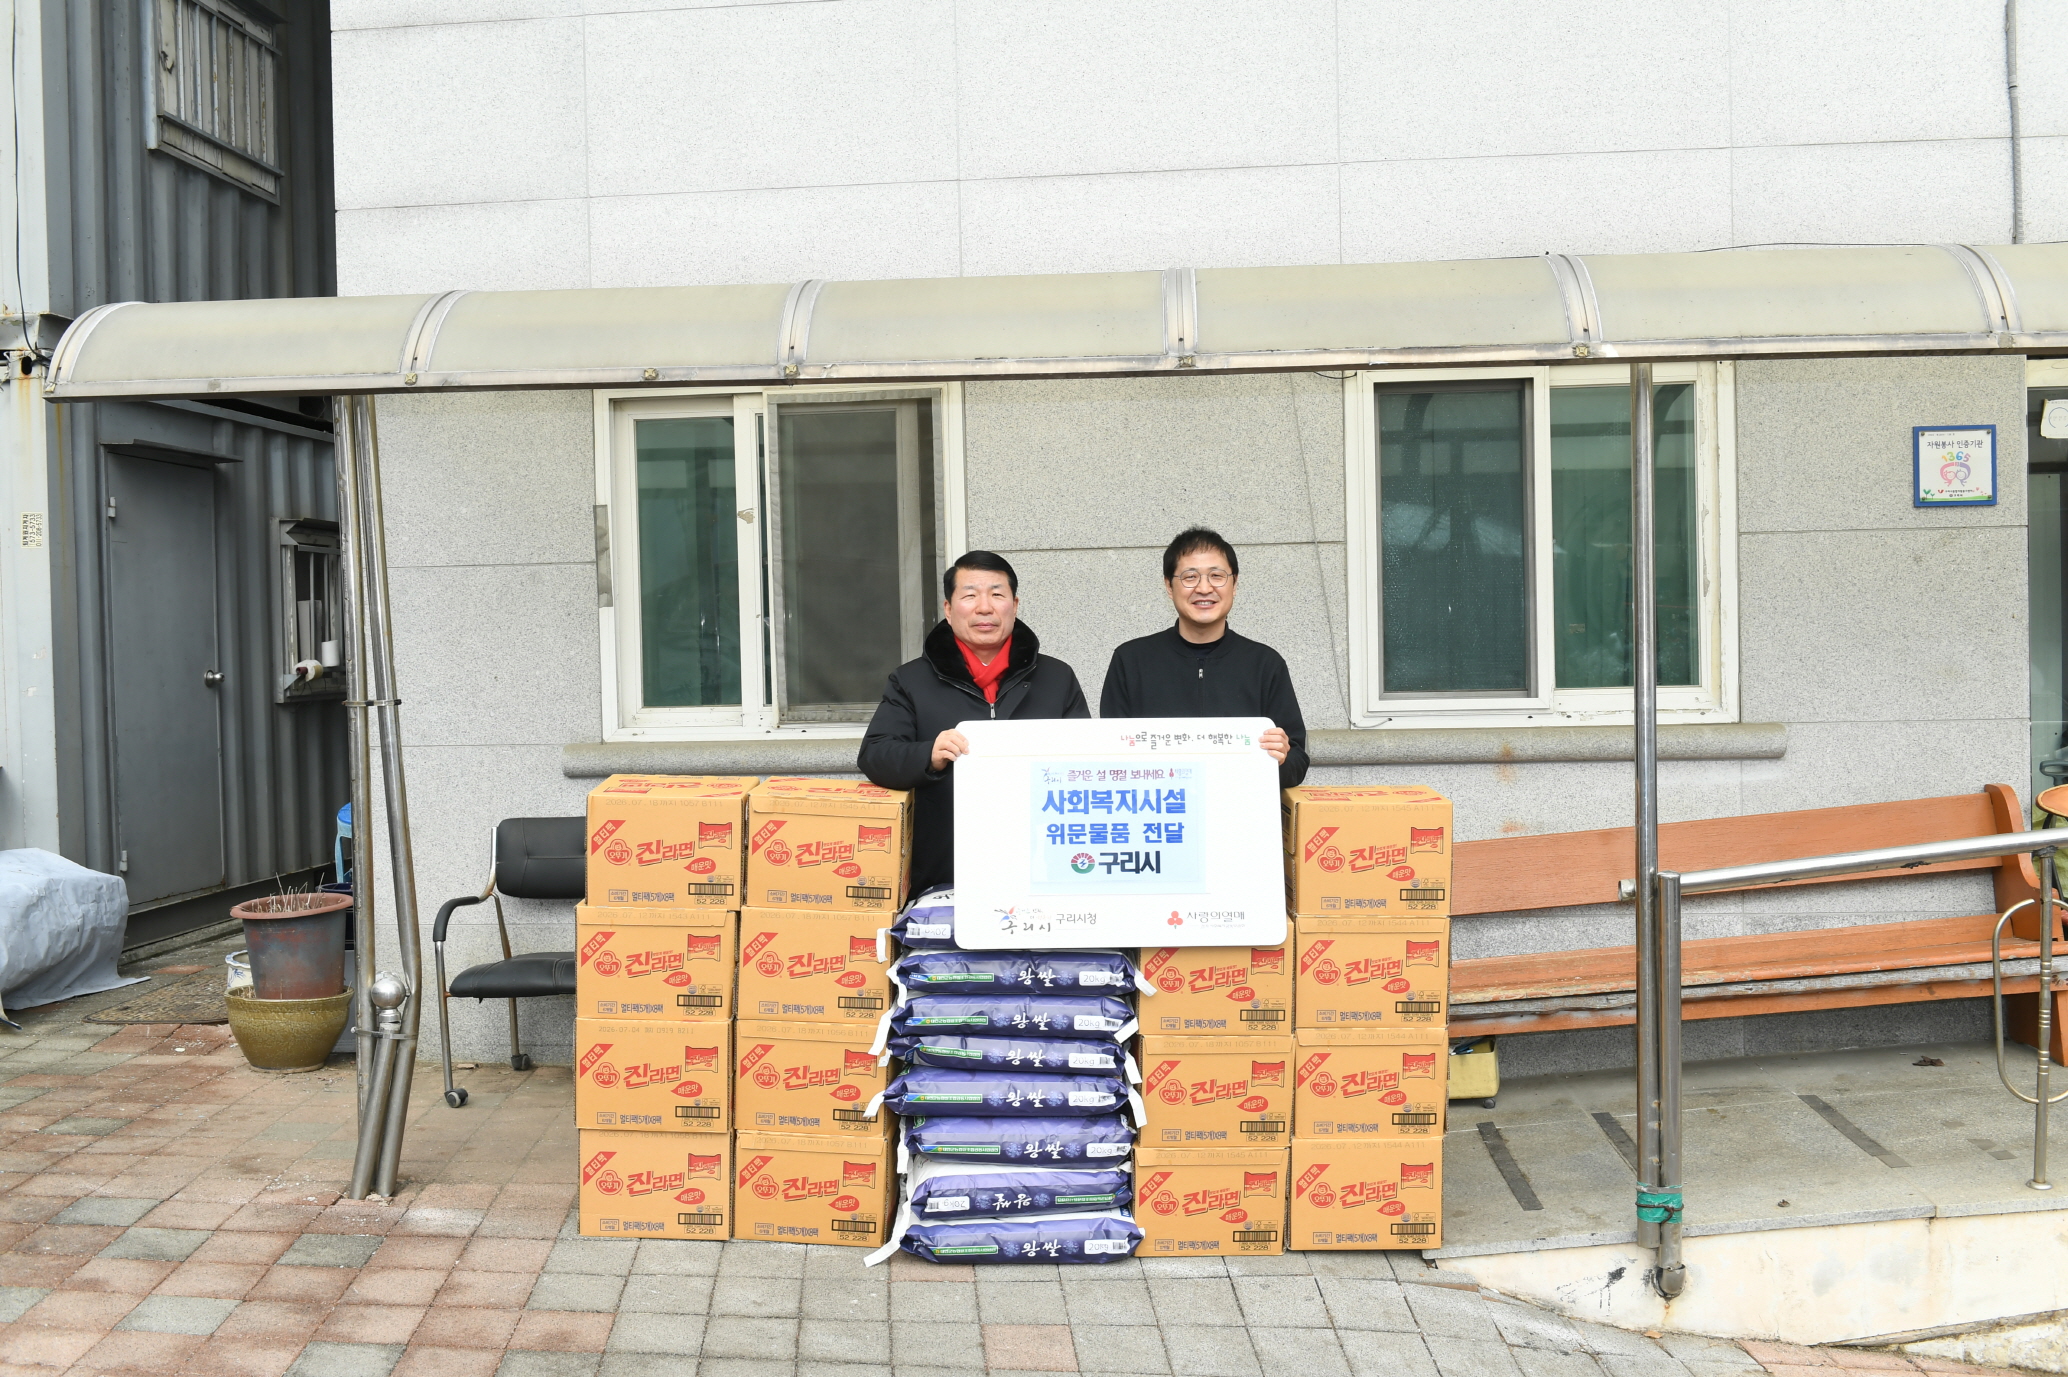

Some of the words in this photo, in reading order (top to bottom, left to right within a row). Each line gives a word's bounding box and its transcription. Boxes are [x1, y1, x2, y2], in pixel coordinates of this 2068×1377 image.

[1927, 440, 1954, 449] 자원봉사
[1957, 440, 1984, 448] 인증기관
[1942, 451, 1971, 462] 1365
[1121, 731, 1147, 746] 나눔으로
[1150, 734, 1171, 750] 즐거운
[1208, 733, 1232, 745] 행복한
[1236, 734, 1250, 745] 나눔
[1067, 770, 1093, 781] 즐거운
[1096, 770, 1106, 781] 설
[1110, 769, 1127, 781] 명절
[1130, 769, 1165, 780] 보내세요
[1042, 788, 1186, 814] 사회복지시설
[593, 822, 616, 846] 멀티팩
[754, 822, 778, 845] 멀티팩
[1046, 824, 1130, 844] 위문물품
[1143, 822, 1184, 843] 전달
[1307, 829, 1330, 853] 멀티팩
[636, 840, 693, 864] 진라면
[796, 842, 854, 866] 진라면
[1099, 851, 1161, 874] 구리시
[1349, 844, 1407, 872] 진라면
[691, 861, 712, 871] 매운맛
[838, 866, 857, 875] 매운맛
[1392, 869, 1411, 879] 매운맛
[1056, 913, 1097, 924] 구리시청
[1187, 911, 1245, 923] 사랑의열매
[583, 934, 607, 957] 멀티팩
[745, 934, 768, 958] 멀티팩
[1303, 942, 1326, 966] 멀티팩
[625, 951, 684, 976] 진라면
[787, 953, 844, 978] 진라면
[1146, 949, 1170, 973] 멀티팩
[1344, 957, 1402, 984] 진라면
[668, 975, 688, 984] 매운맛
[841, 975, 862, 985] 매운맛
[1188, 965, 1247, 992] 진라면
[1387, 982, 1406, 991] 매운맛
[1232, 990, 1251, 999] 매운맛
[581, 1045, 604, 1069] 멀티팩
[742, 1046, 765, 1070] 멀티팩
[1299, 1055, 1323, 1078] 멀티팩
[624, 1064, 680, 1088] 진라면
[783, 1065, 839, 1091] 진라면
[1148, 1062, 1171, 1086] 멀티팩
[1341, 1070, 1399, 1097] 진라면
[678, 1084, 698, 1095] 매운맛
[836, 1088, 856, 1098] 매운맛
[1190, 1079, 1247, 1104] 진라면
[1384, 1094, 1403, 1104] 매운맛
[1243, 1099, 1264, 1110] 매운맛
[585, 1153, 607, 1176] 멀티팩
[741, 1157, 764, 1181] 멀티팩
[627, 1171, 683, 1195] 진라면
[782, 1176, 838, 1202] 진라면
[1141, 1174, 1164, 1197] 멀티팩
[1298, 1166, 1322, 1189] 멀티팩
[680, 1192, 701, 1202] 매운맛
[835, 1198, 855, 1209] 매운맛
[1182, 1188, 1240, 1215] 진라면
[1339, 1180, 1398, 1207] 진라면
[1225, 1212, 1244, 1221] 매운맛
[1382, 1204, 1402, 1214] 매운맛
